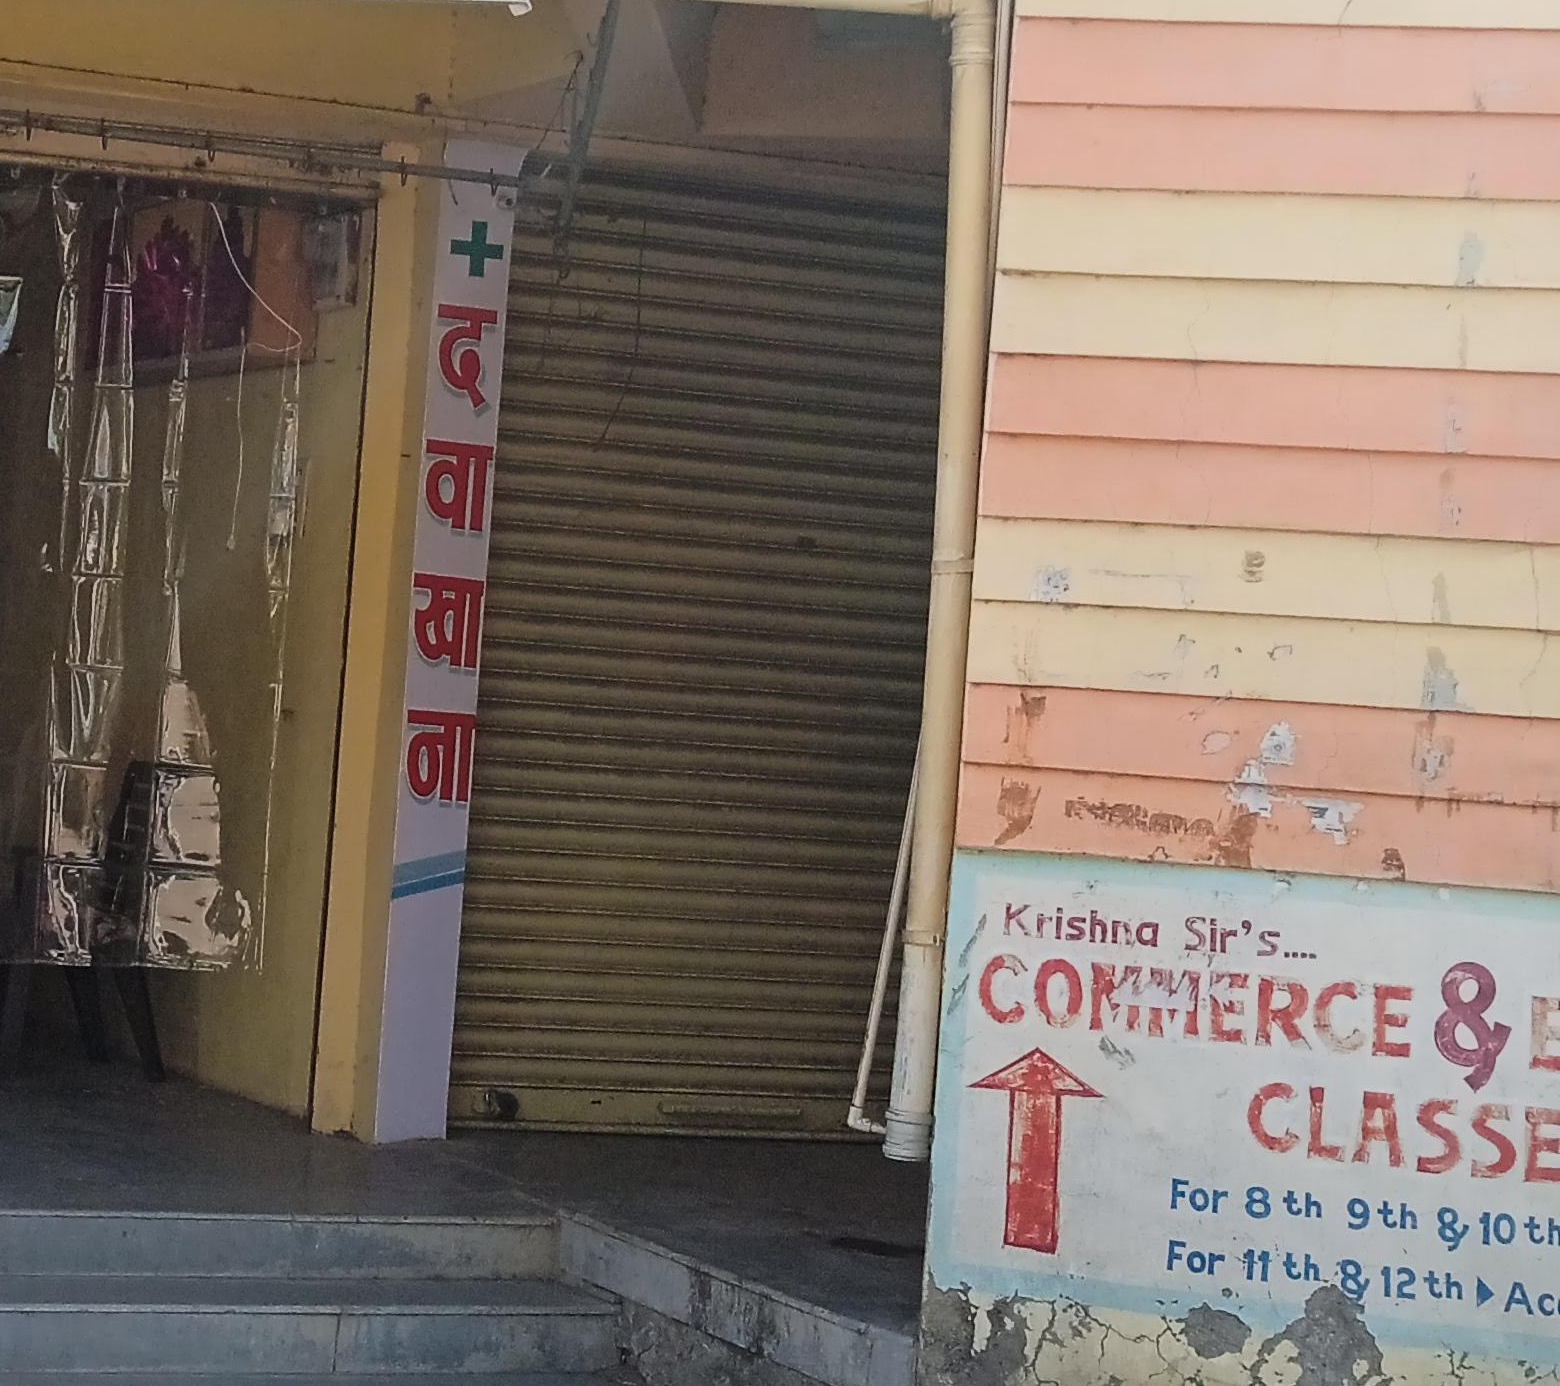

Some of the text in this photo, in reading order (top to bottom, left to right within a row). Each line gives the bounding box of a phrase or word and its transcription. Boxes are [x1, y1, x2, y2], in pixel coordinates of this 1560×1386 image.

[1002, 901, 1159, 949] Krishna
[978, 953, 1415, 1059] COMMERCE
[1433, 961, 1512, 1094] &
[1170, 1177, 1229, 1215] For
[1166, 1239, 1226, 1276] For
[1339, 1259, 1371, 1302] &
[1504, 1281, 1560, 1317] Ac
